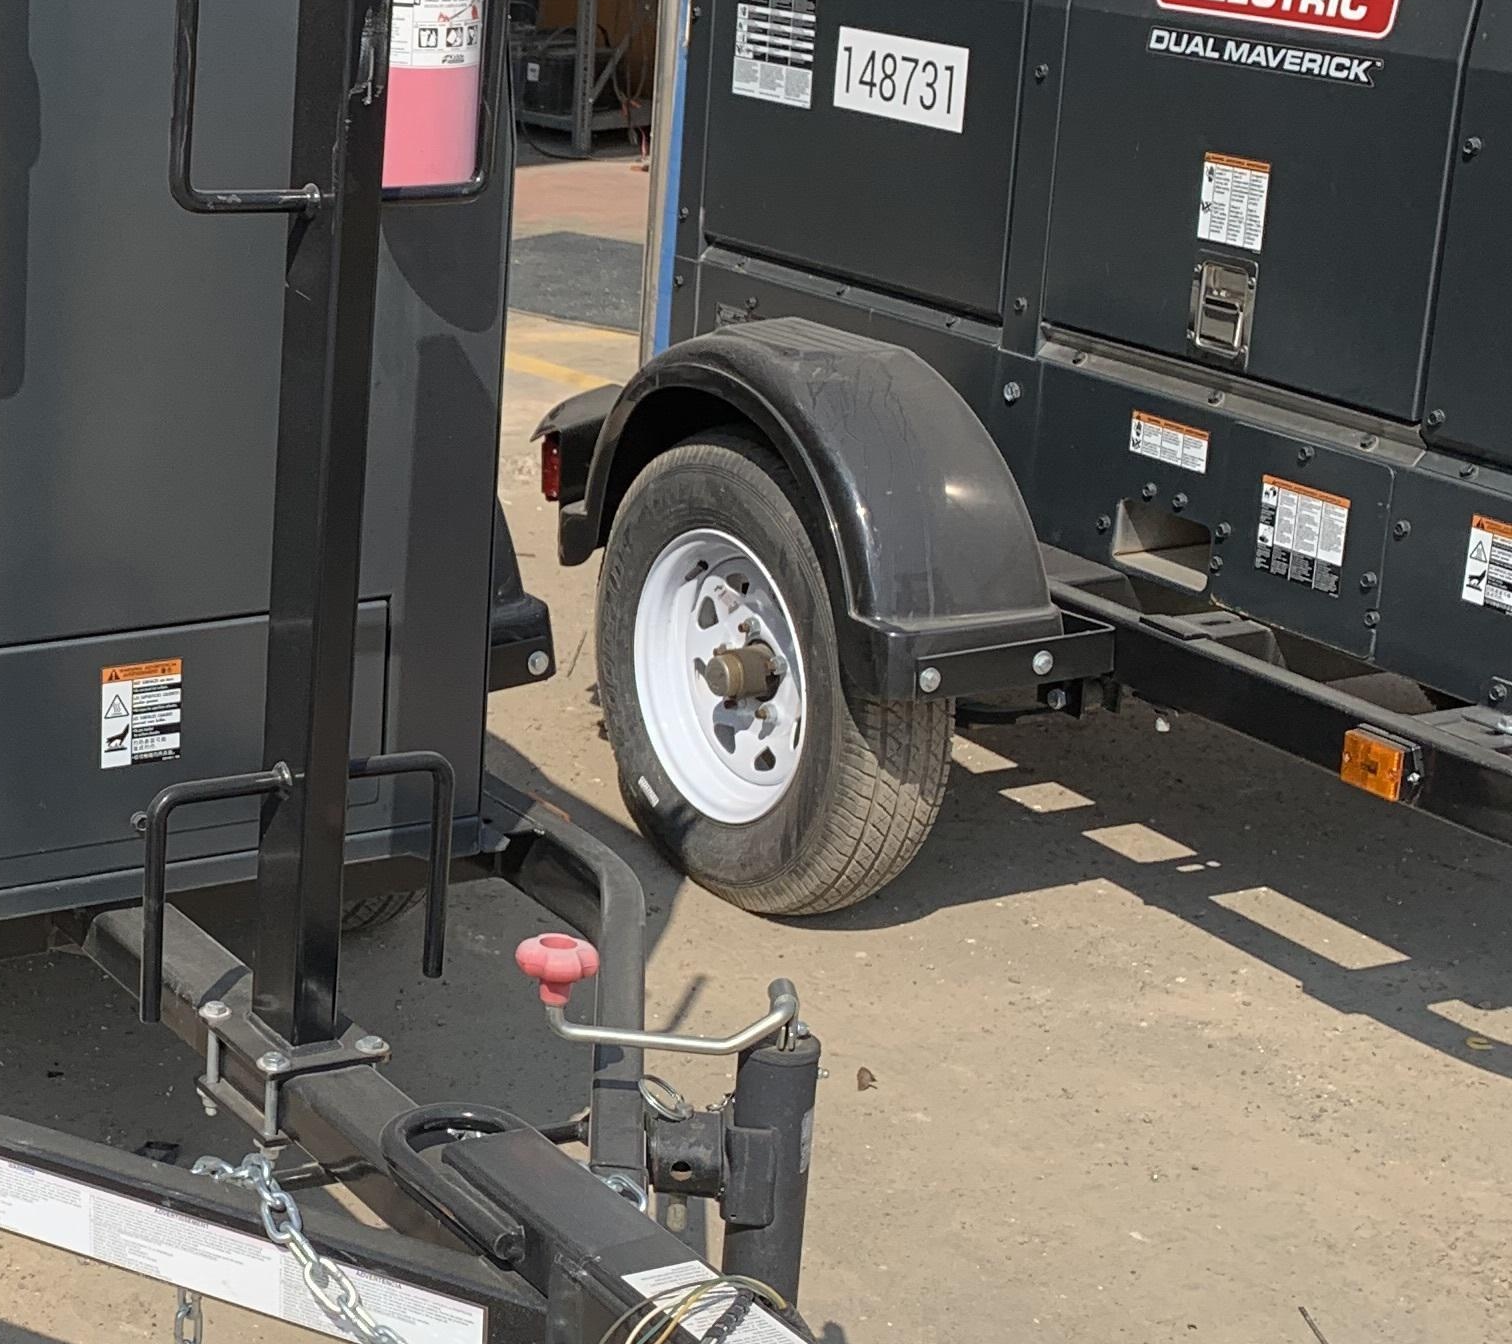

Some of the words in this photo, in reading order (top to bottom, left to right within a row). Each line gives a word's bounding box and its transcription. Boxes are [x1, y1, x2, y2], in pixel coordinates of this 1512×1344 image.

[843, 46, 954, 115] 148731
[1149, 29, 1220, 59] DUAL
[1223, 41, 1374, 83] MAVERICK
